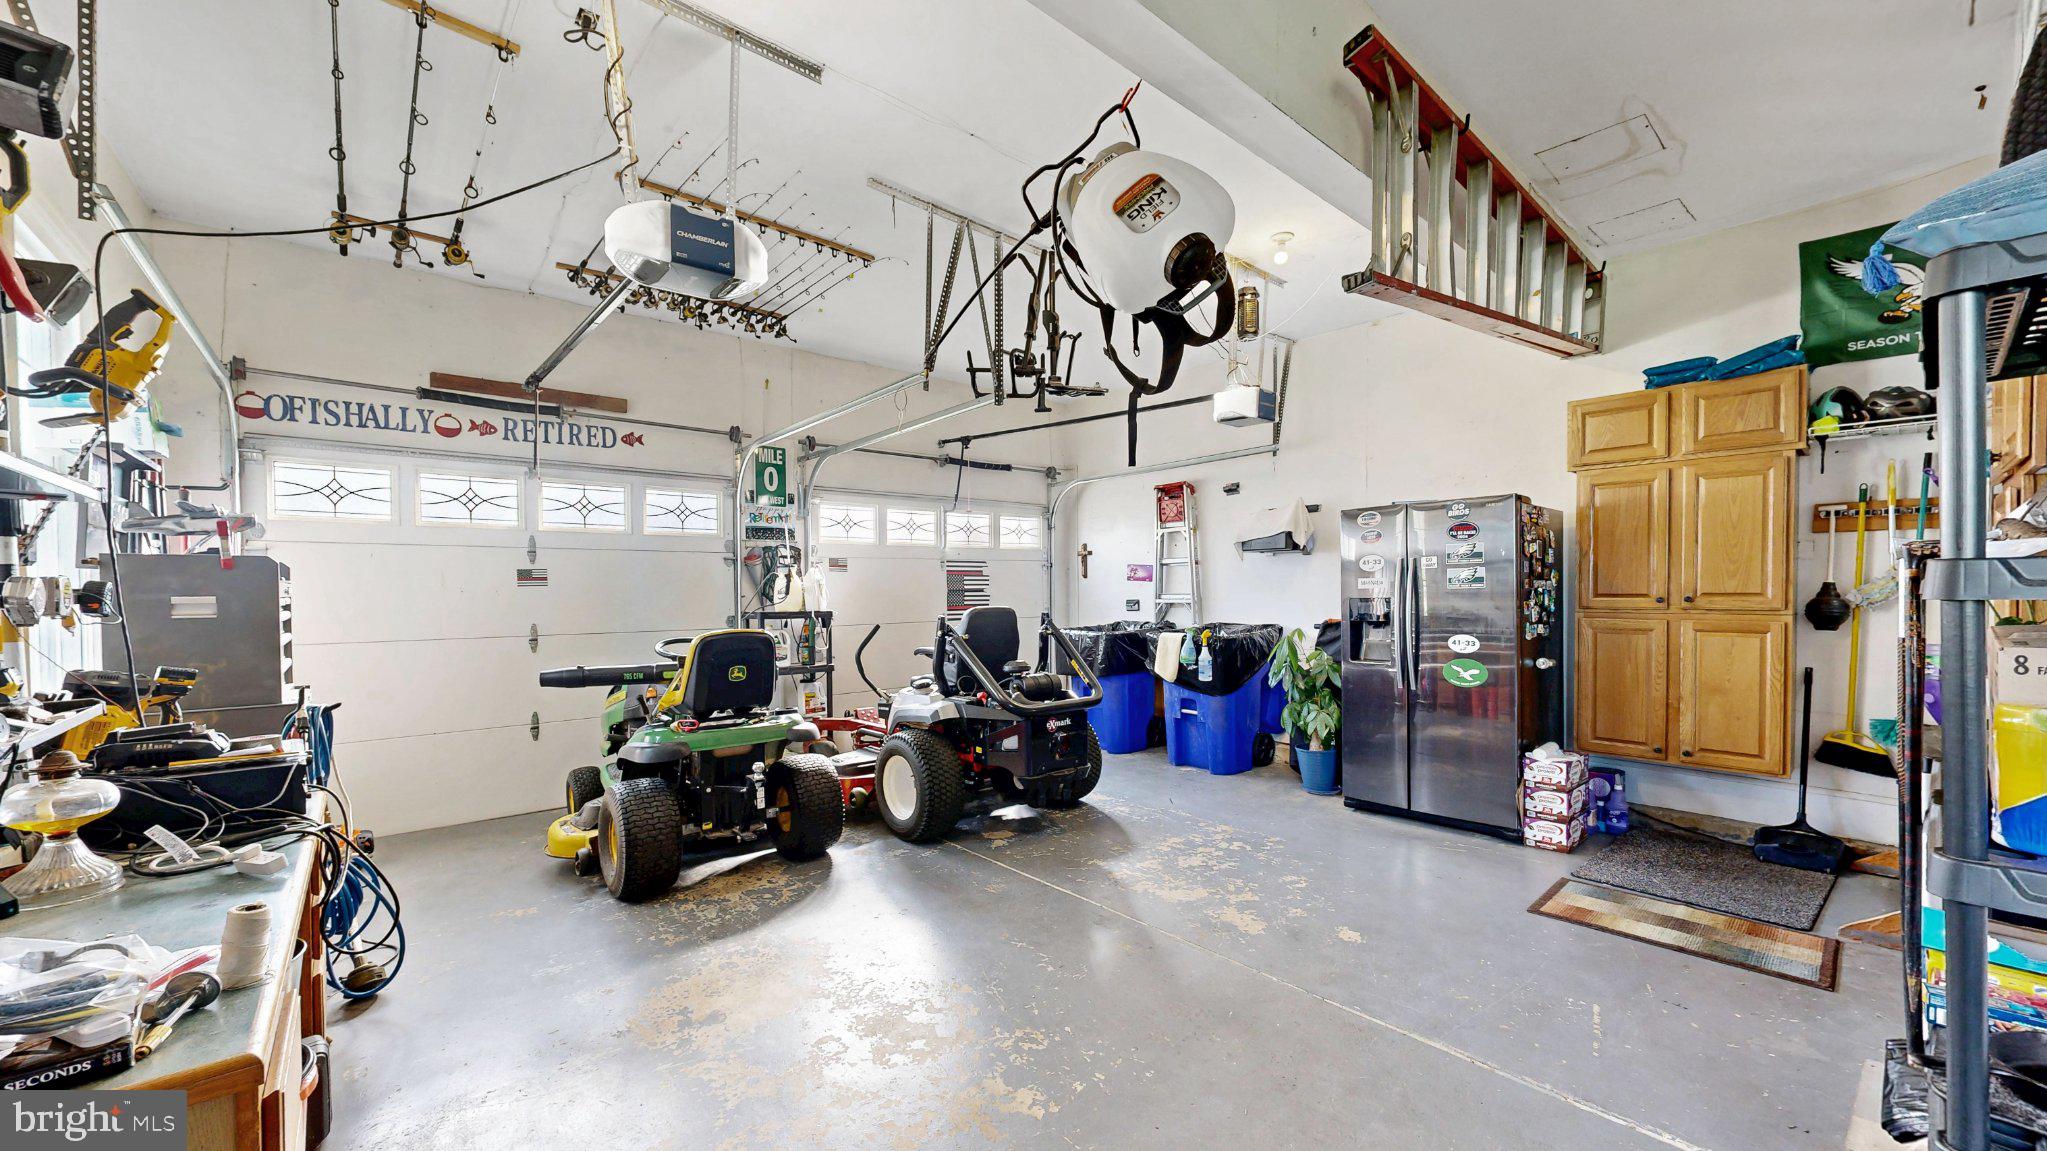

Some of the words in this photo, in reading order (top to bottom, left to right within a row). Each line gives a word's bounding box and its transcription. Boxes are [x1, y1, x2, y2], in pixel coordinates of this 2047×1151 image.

[1126, 187, 1168, 221] KING
[1139, 199, 1164, 220] FIELD
[676, 230, 729, 248] CHAMBERLAIN
[1847, 333, 1911, 351] SEASON
[264, 393, 435, 435] OFISHALLY
[502, 416, 618, 449] RETIRED
[758, 447, 783, 465] MILE
[763, 466, 779, 492] 0
[1447, 508, 1470, 517] BIRDS
[1362, 558, 1382, 566] 41-33
[2013, 655, 2030, 675] 8
[3, 1060, 93, 1090] SECONDS
